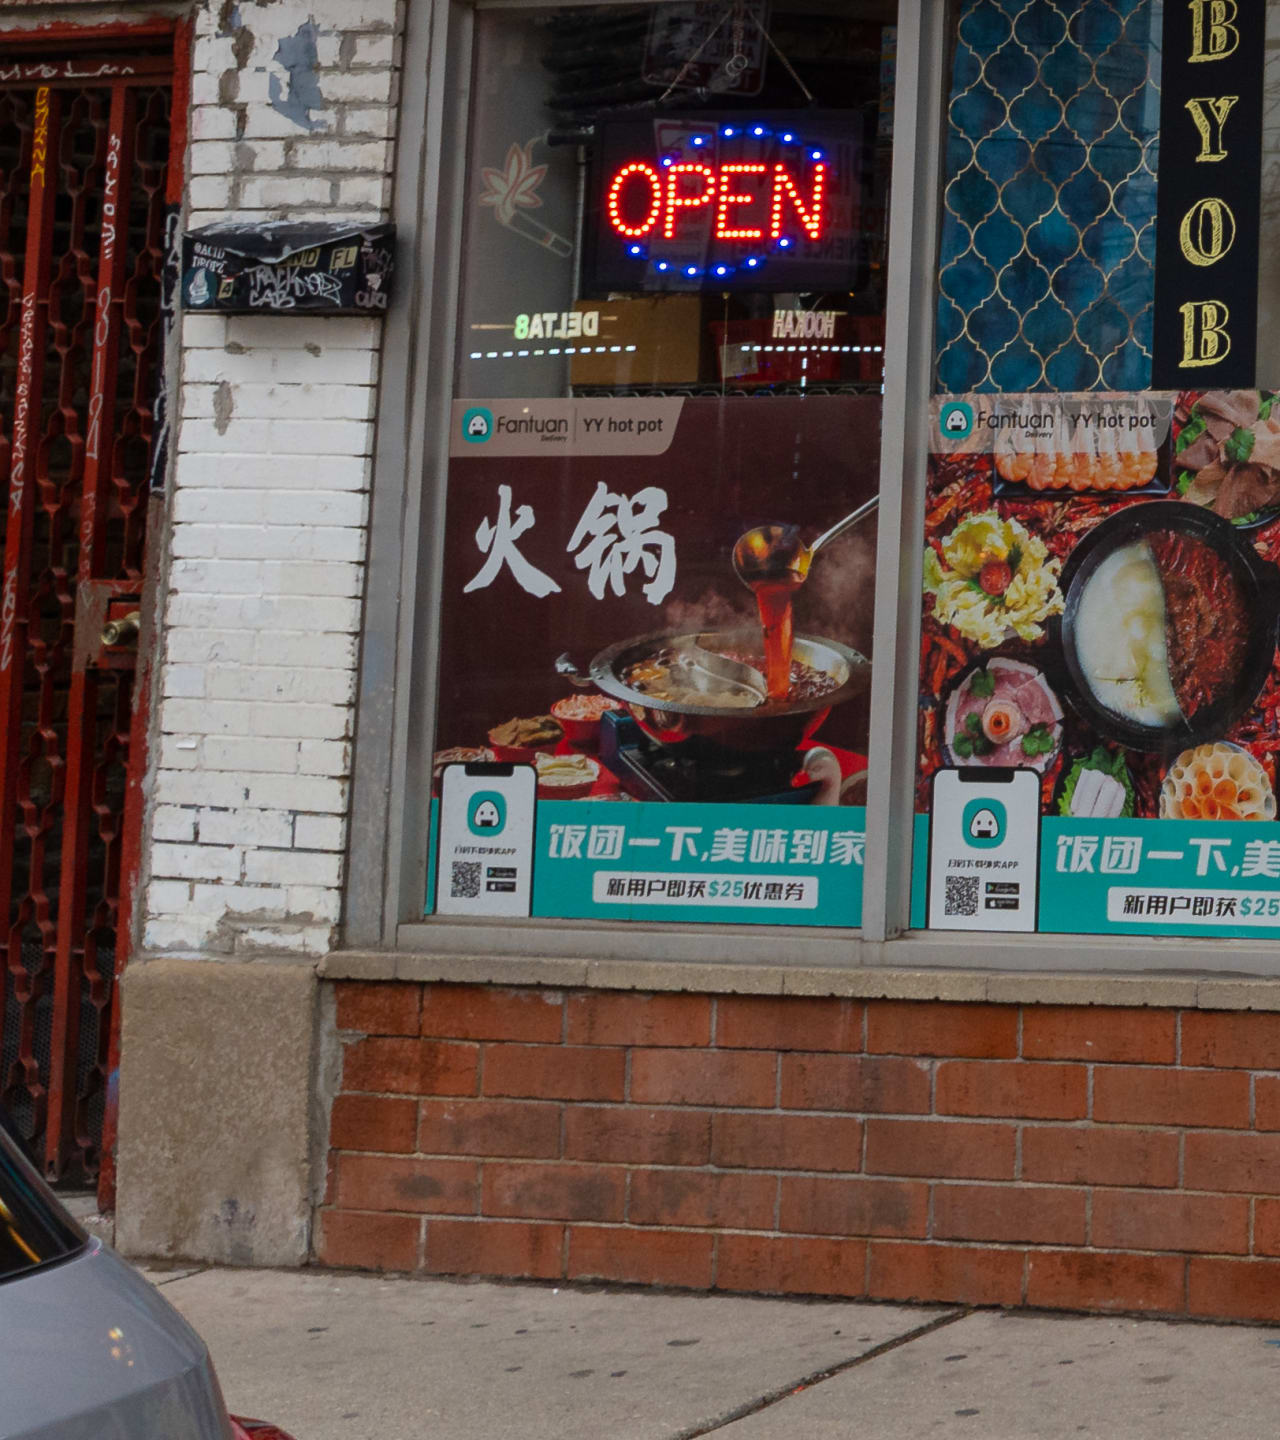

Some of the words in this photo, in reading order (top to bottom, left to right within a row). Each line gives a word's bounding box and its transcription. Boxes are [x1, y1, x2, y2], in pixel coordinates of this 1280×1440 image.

[607, 162, 826, 240] OPEN
[282, 248, 318, 267] ND
[332, 248, 354, 266] FL
[496, 415, 569, 434] Fantuan
[583, 418, 605, 433] YY
[608, 417, 634, 433] hot
[637, 418, 664, 436] pot
[977, 410, 1054, 429] Fantuan
[1071, 413, 1093, 428] YY
[1096, 412, 1125, 429] hot
[1129, 414, 1157, 431] pot
[1024, 430, 1054, 439] Delivery
[463, 480, 678, 607] 火锅
[606, 878, 806, 902] 新用户即获$25优惠券
